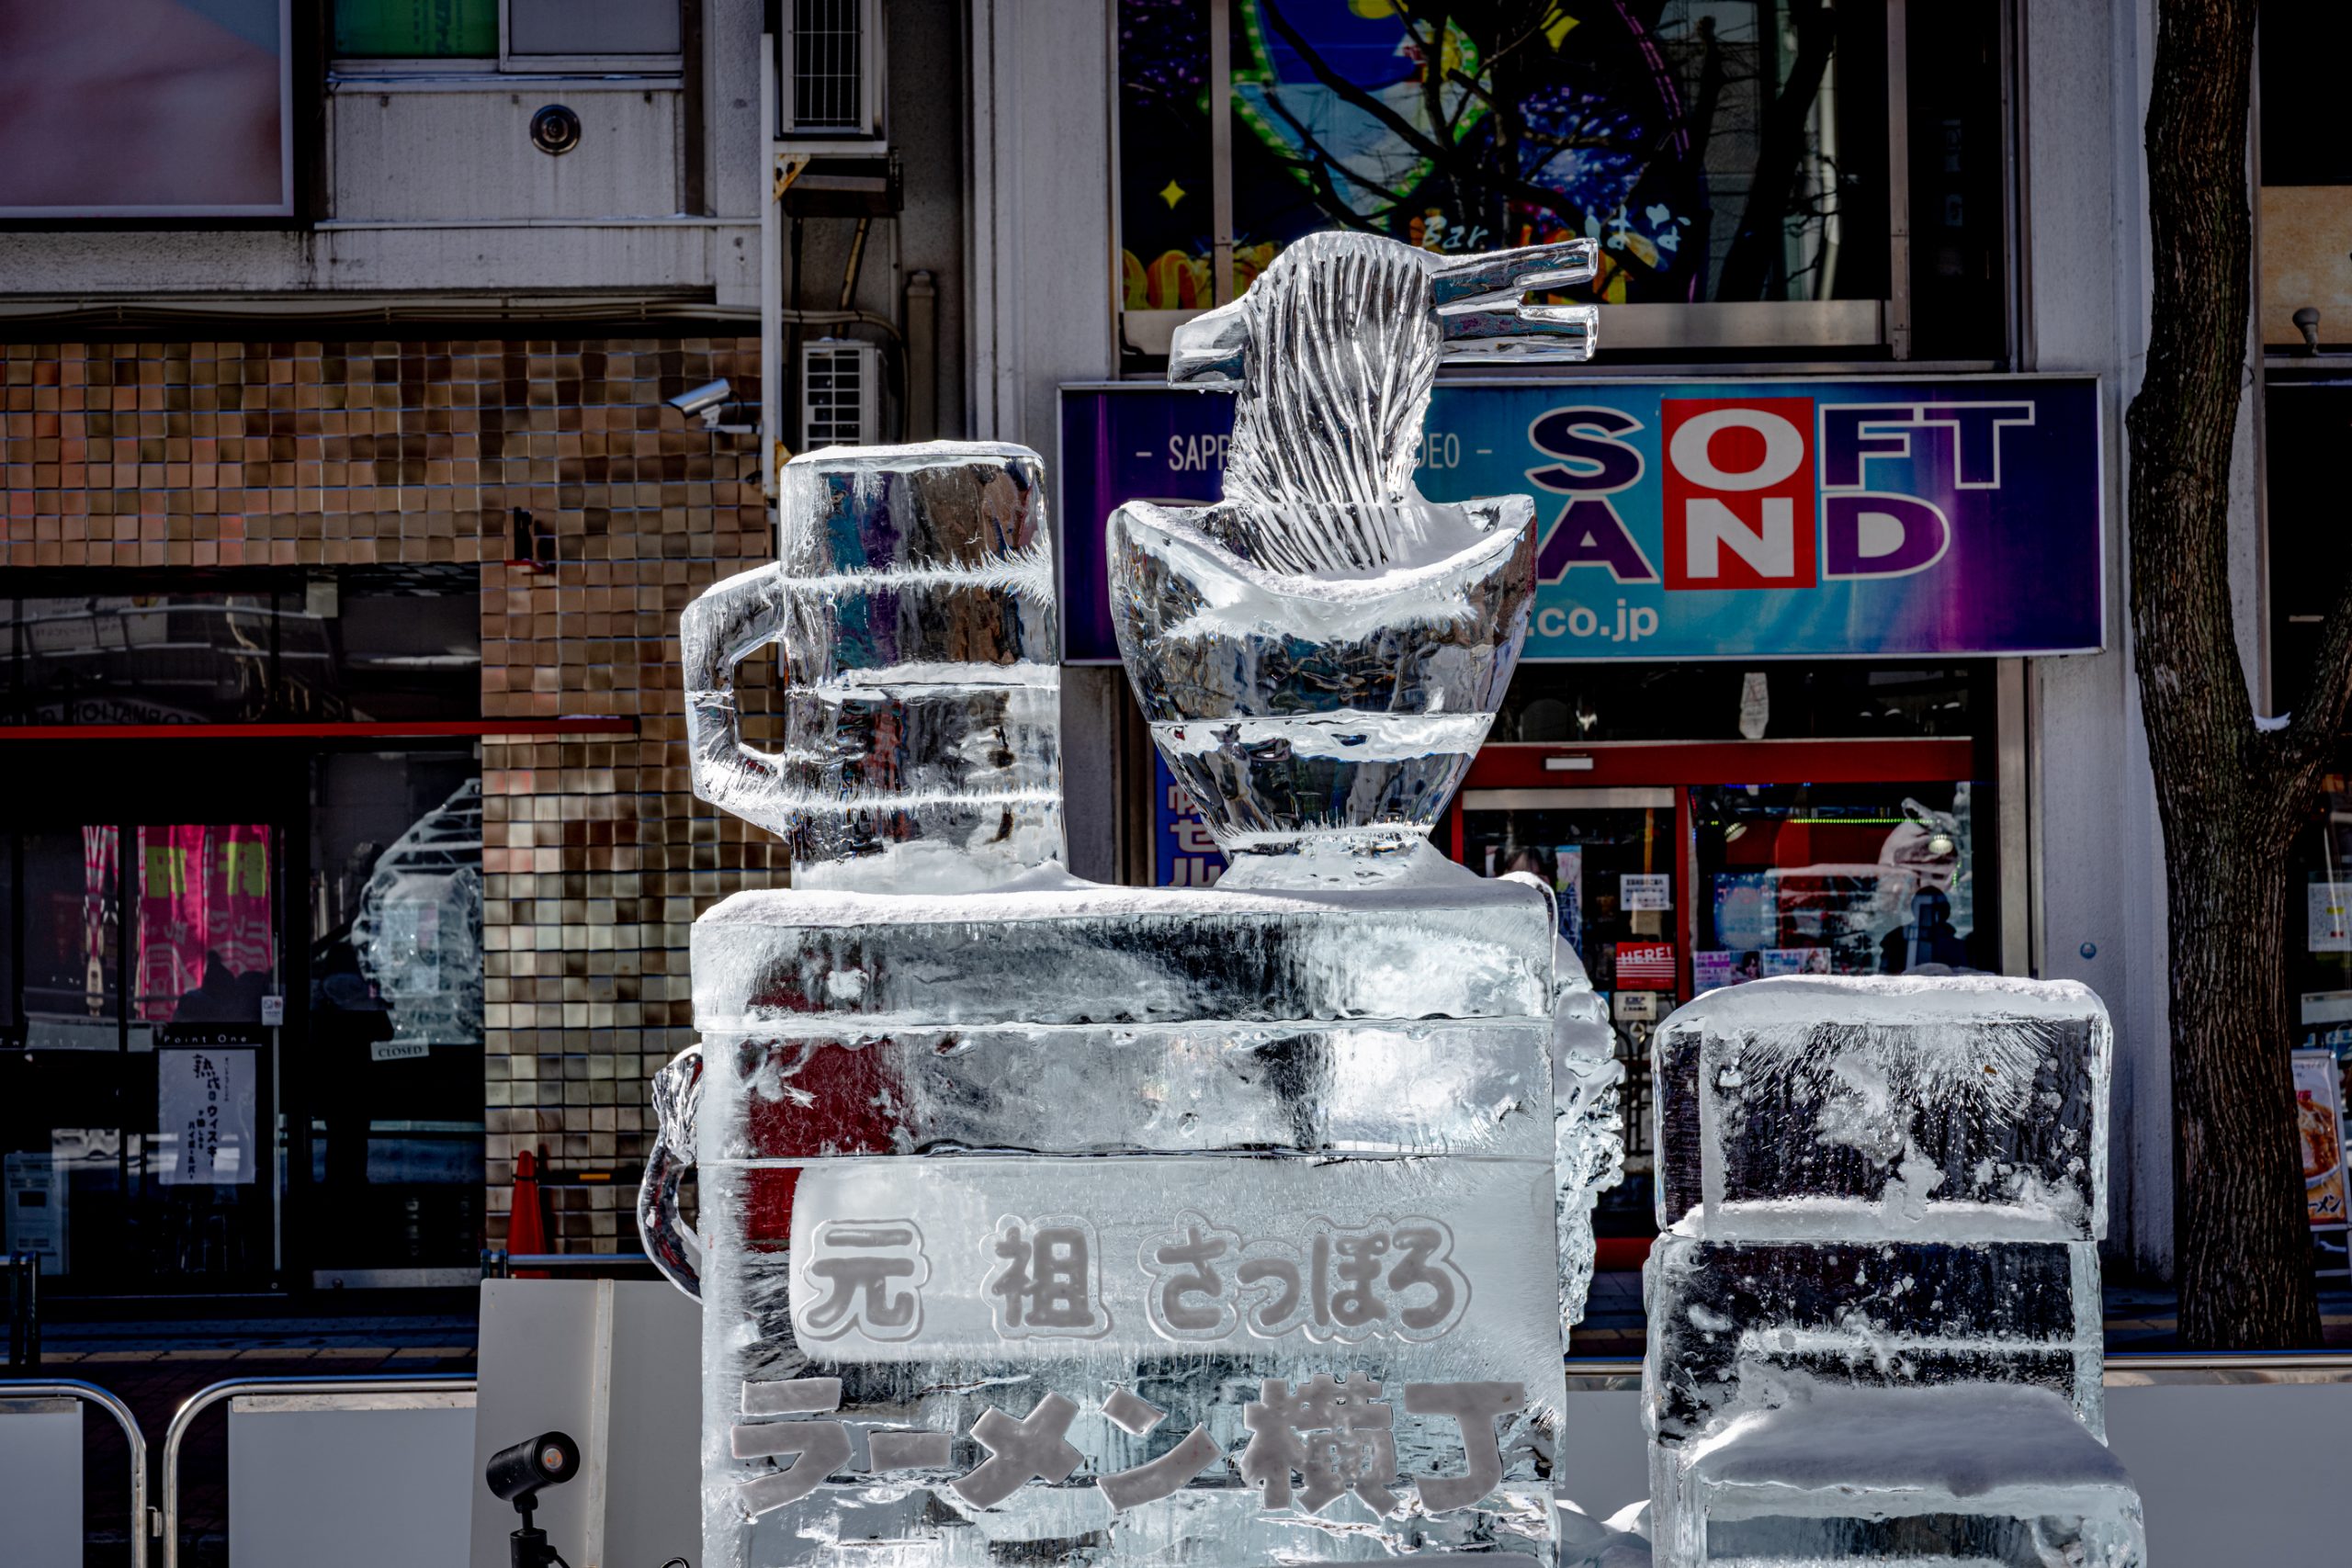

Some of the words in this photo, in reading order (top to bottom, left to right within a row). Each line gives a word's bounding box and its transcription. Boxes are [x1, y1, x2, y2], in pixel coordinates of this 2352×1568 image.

[1525, 400, 2035, 494] SOFT
[1620, 945, 1672, 965] HERE!
[164, 1034, 208, 1044] Point
[217, 1033, 248, 1044] One
[378, 1045, 423, 1057] CLOSED
[731, 1371, 1526, 1522] ラーメン横丁
